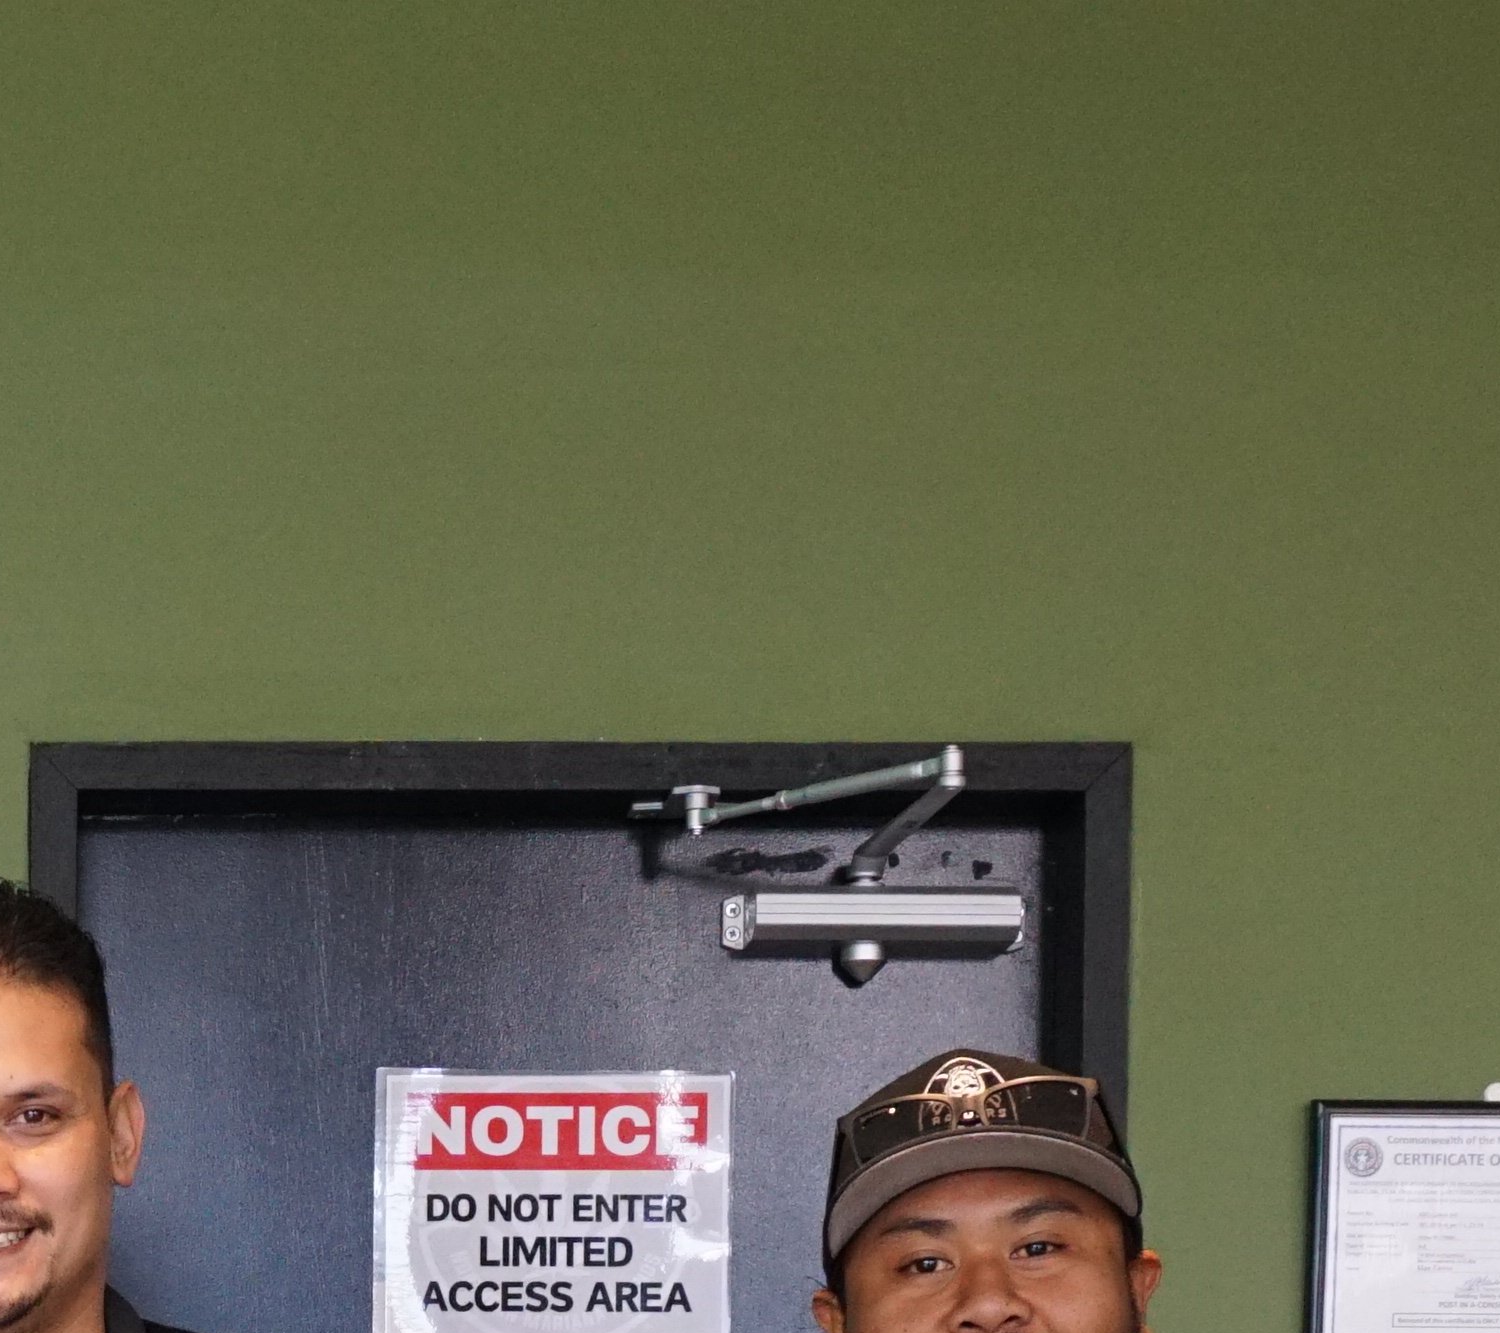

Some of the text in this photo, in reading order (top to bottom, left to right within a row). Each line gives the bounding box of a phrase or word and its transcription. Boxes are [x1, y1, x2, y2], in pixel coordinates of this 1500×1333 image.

[419, 1105, 699, 1157] NOTICE
[1393, 1152, 1485, 1167] CERTIFICATE
[427, 1193, 687, 1223] DO NOT ENTER
[480, 1236, 632, 1267] LIMITED
[423, 1282, 692, 1313] ACCESS AREA
